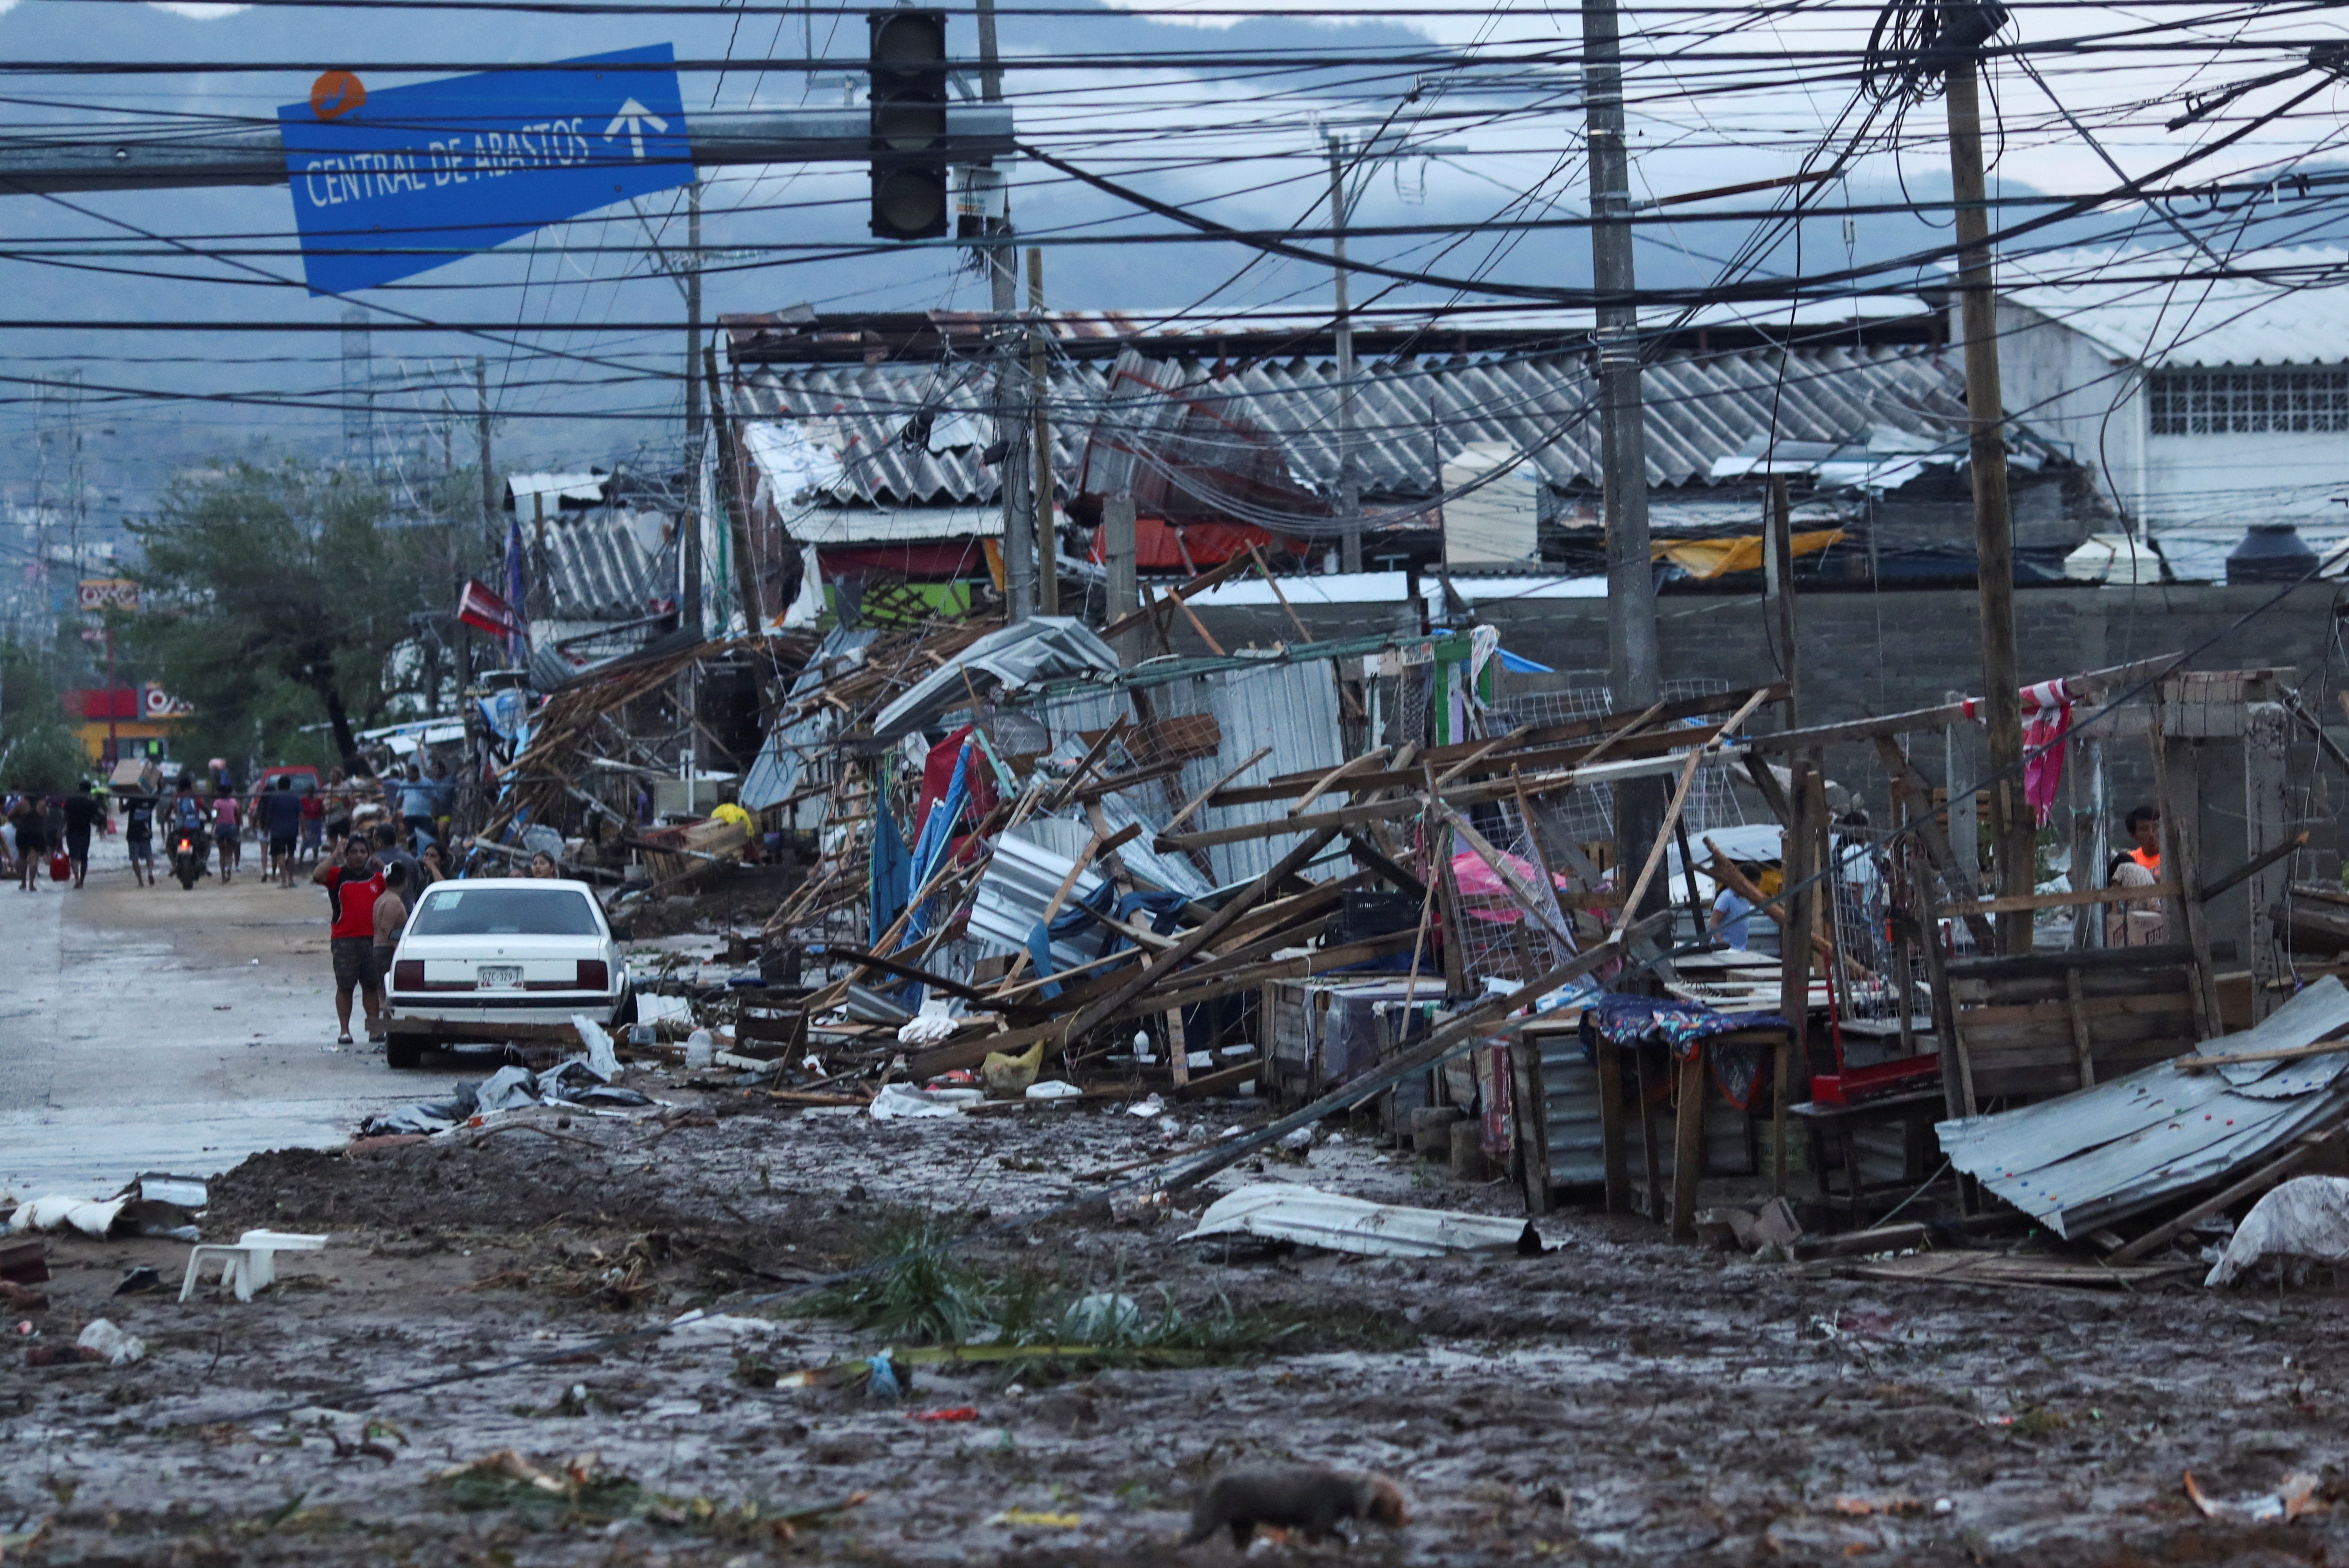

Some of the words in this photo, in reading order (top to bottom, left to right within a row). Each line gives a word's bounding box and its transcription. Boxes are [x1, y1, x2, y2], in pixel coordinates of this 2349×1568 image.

[306, 146, 426, 207] CENTRAL
[429, 138, 467, 186] DE
[475, 117, 589, 179] ABASTOS
